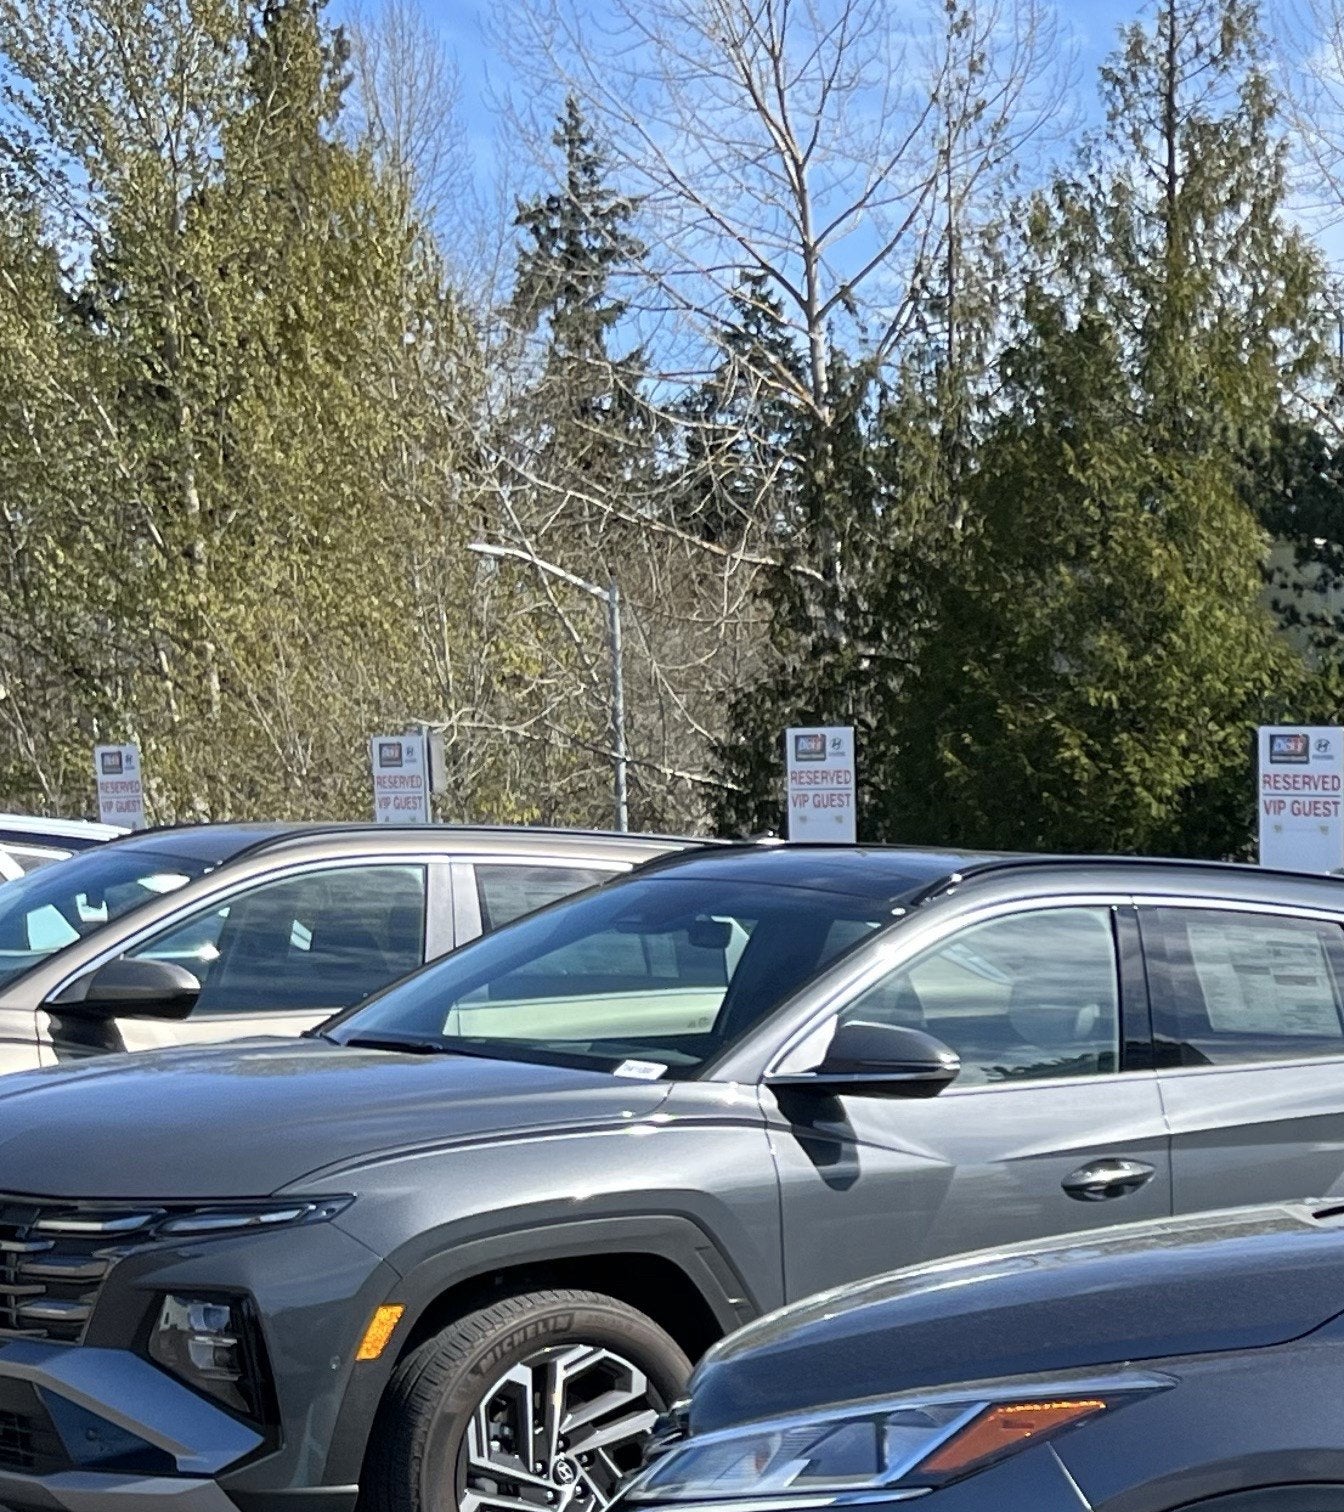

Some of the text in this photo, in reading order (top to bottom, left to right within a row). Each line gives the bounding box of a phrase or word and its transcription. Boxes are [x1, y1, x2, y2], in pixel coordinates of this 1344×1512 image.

[790, 769, 852, 785] RESERVED
[1263, 775, 1340, 791] RESERVED
[791, 793, 852, 808] VIP GUEST
[1263, 799, 1341, 817] VIP GUEST
